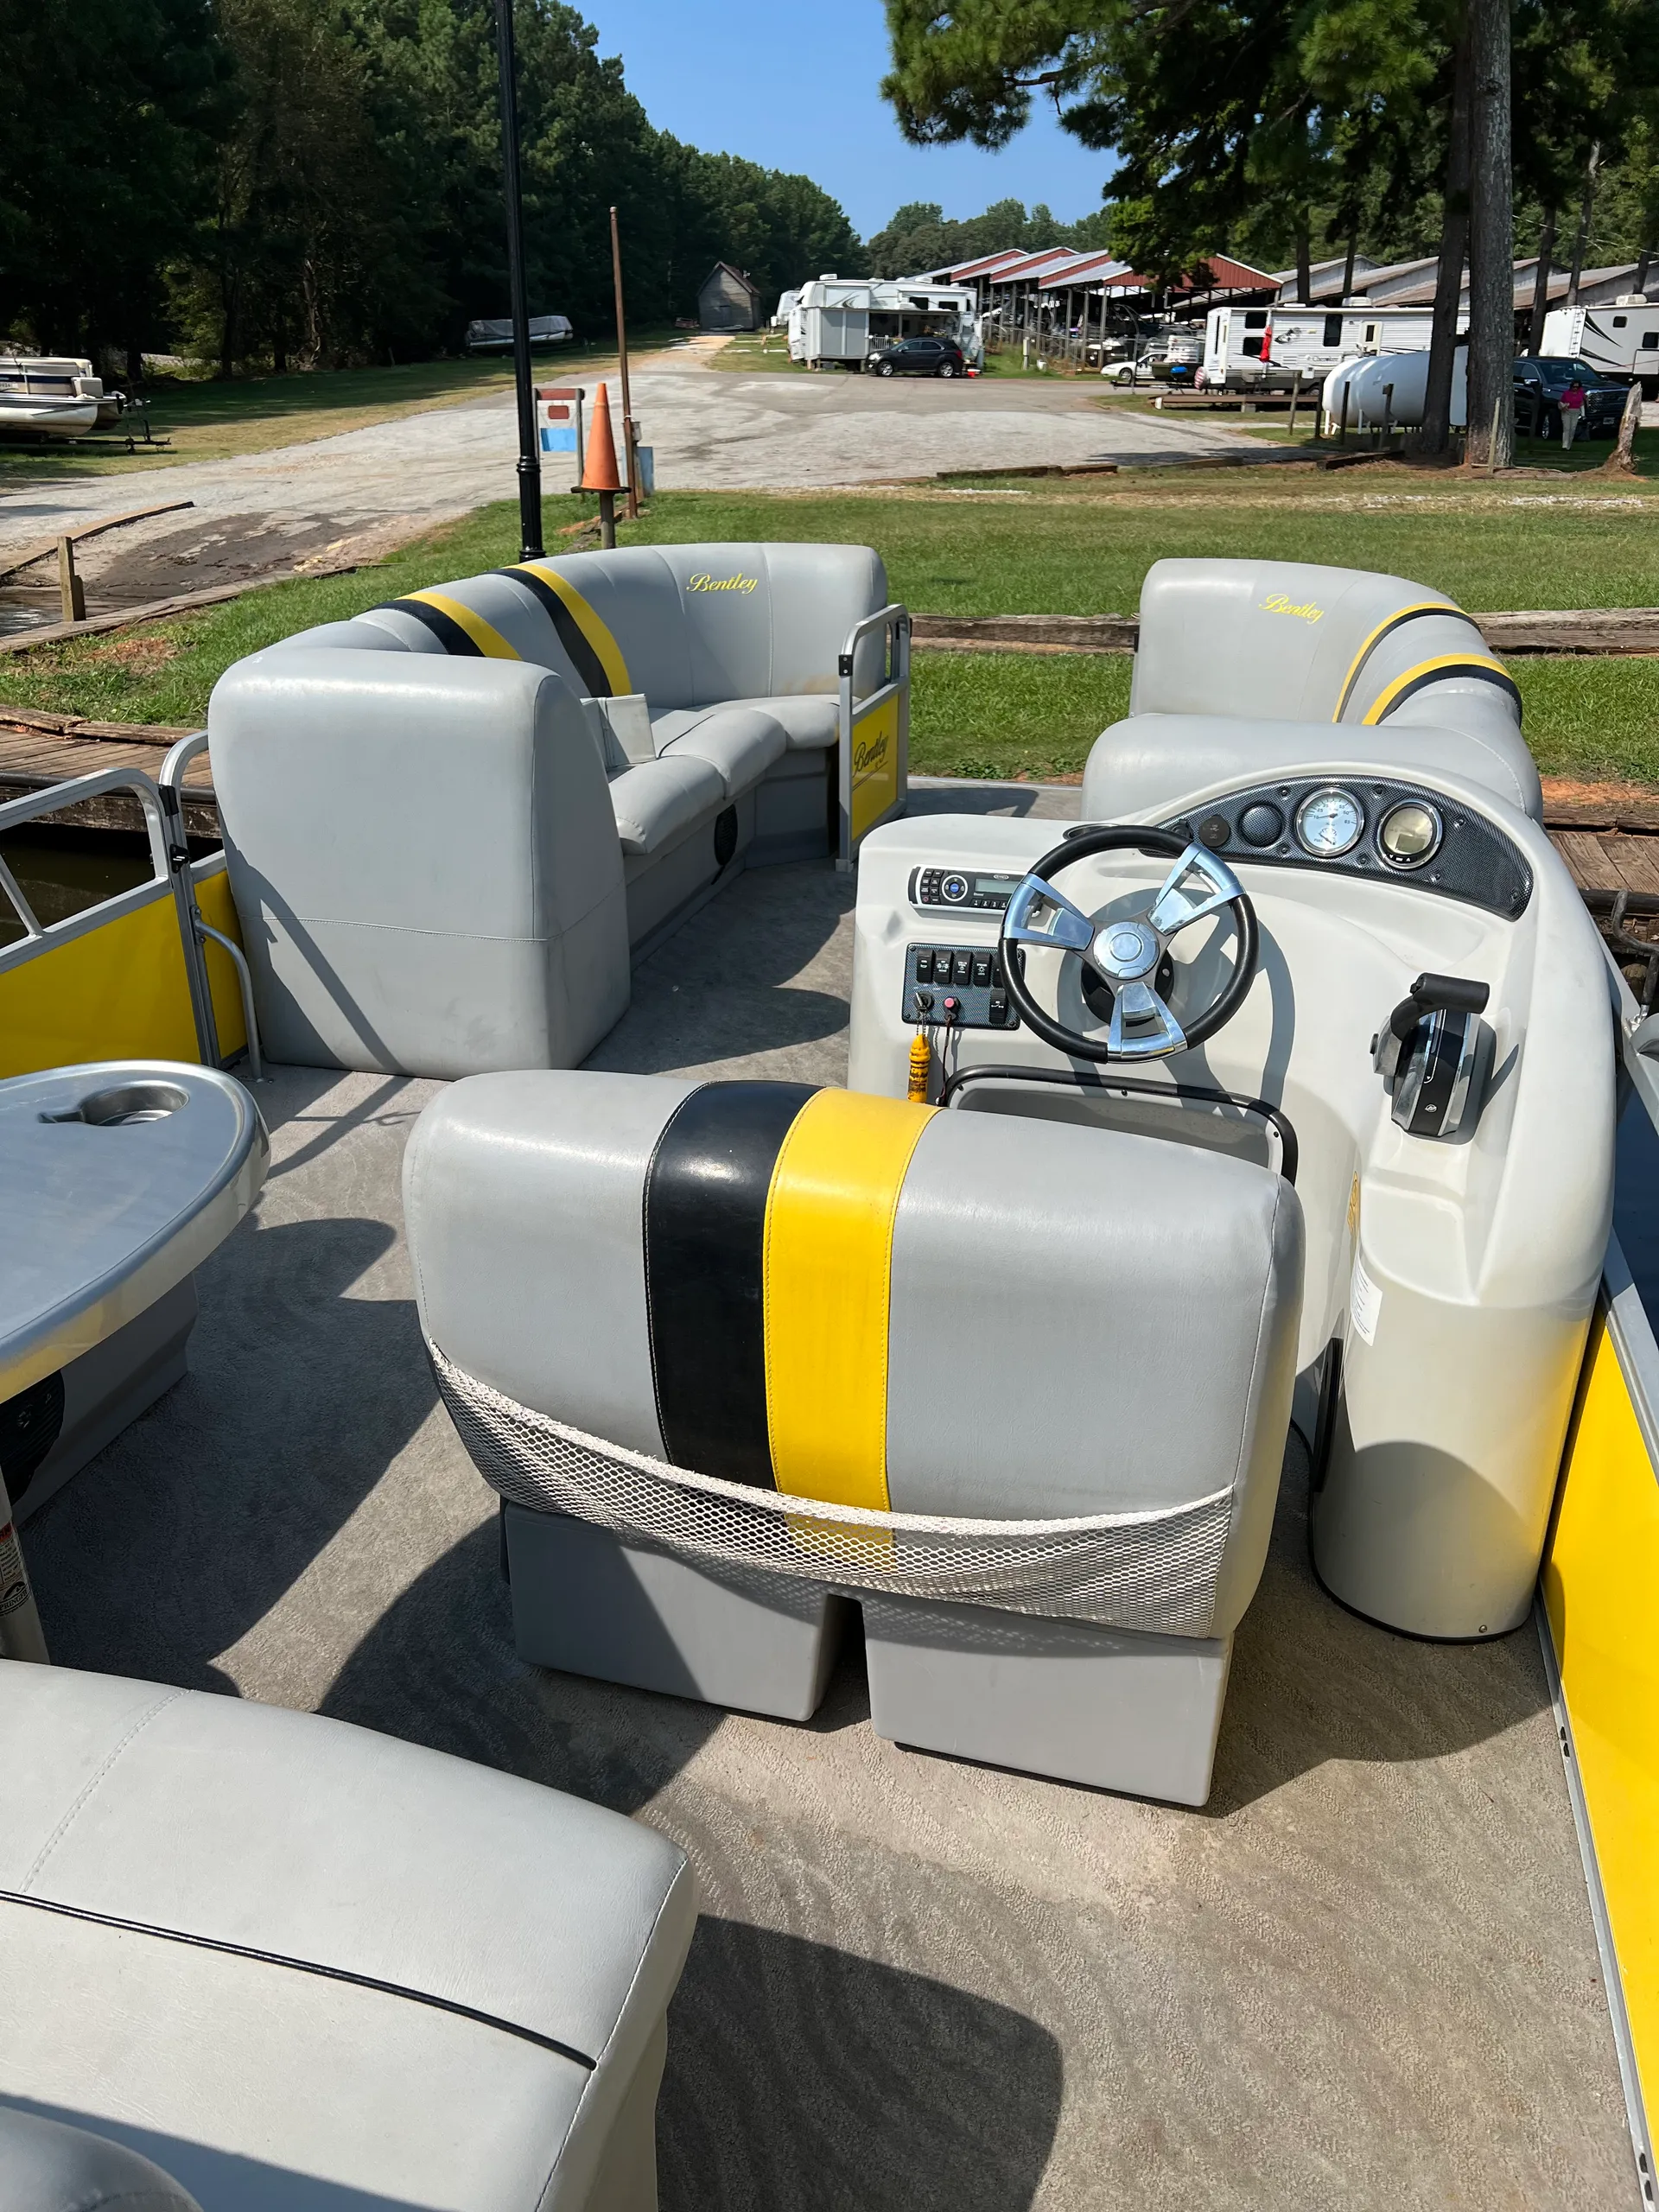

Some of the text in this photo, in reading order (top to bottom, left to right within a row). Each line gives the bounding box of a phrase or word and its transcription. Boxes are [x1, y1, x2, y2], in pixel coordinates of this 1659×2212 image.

[686, 572, 759, 594] Bentley
[1258, 593, 1325, 625] Bentley
[852, 730, 889, 778] Bentley
[0, 1589, 28, 1611] PRINGER
